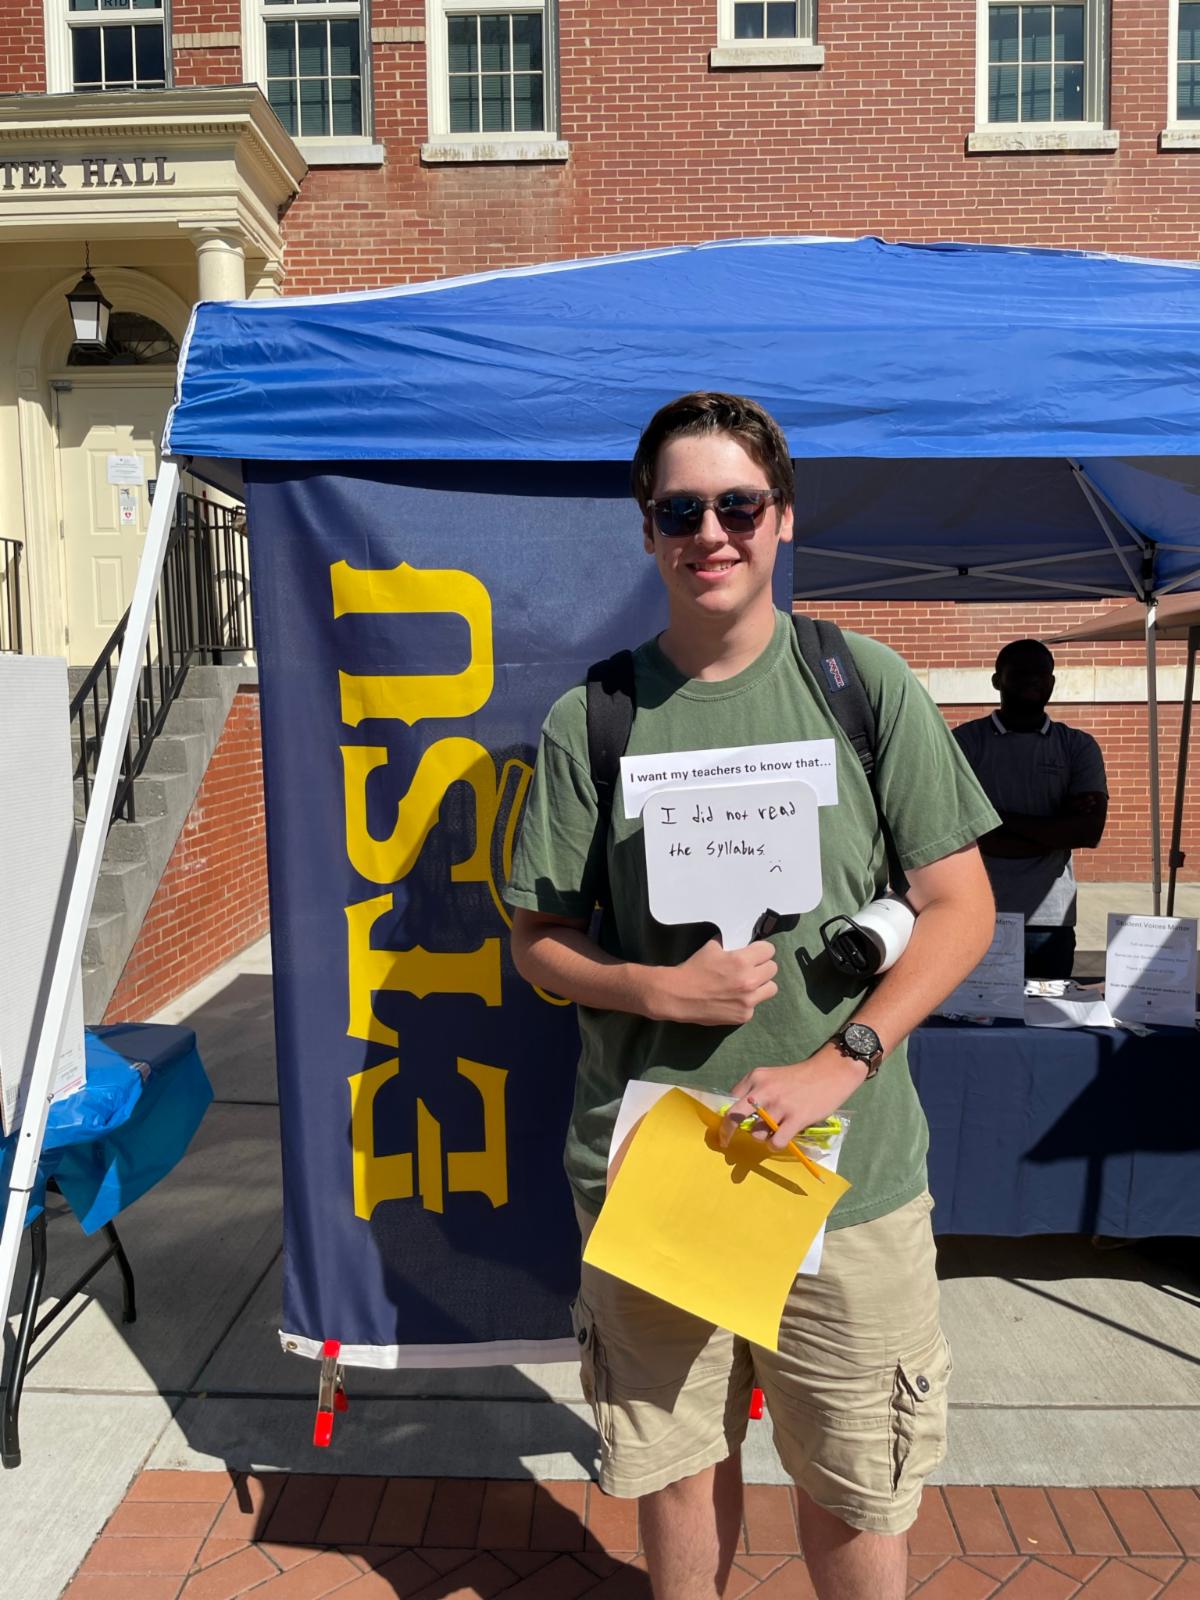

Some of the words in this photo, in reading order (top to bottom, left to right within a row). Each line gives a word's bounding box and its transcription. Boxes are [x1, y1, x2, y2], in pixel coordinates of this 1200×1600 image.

[0, 160, 66, 190] TER
[81, 157, 176, 188] HALL
[630, 773, 634, 783] I
[637, 771, 667, 782] want
[670, 770, 689, 780] my
[692, 765, 741, 778] teachers
[744, 764, 757, 773] to
[760, 762, 792, 771] know
[795, 758, 832, 768] that...
[660, 807, 677, 825] I
[692, 804, 714, 824] did
[726, 809, 748, 821] not
[758, 801, 796, 821] read
[669, 842, 691, 857] the
[330, 560, 510, 1222] ETSU
